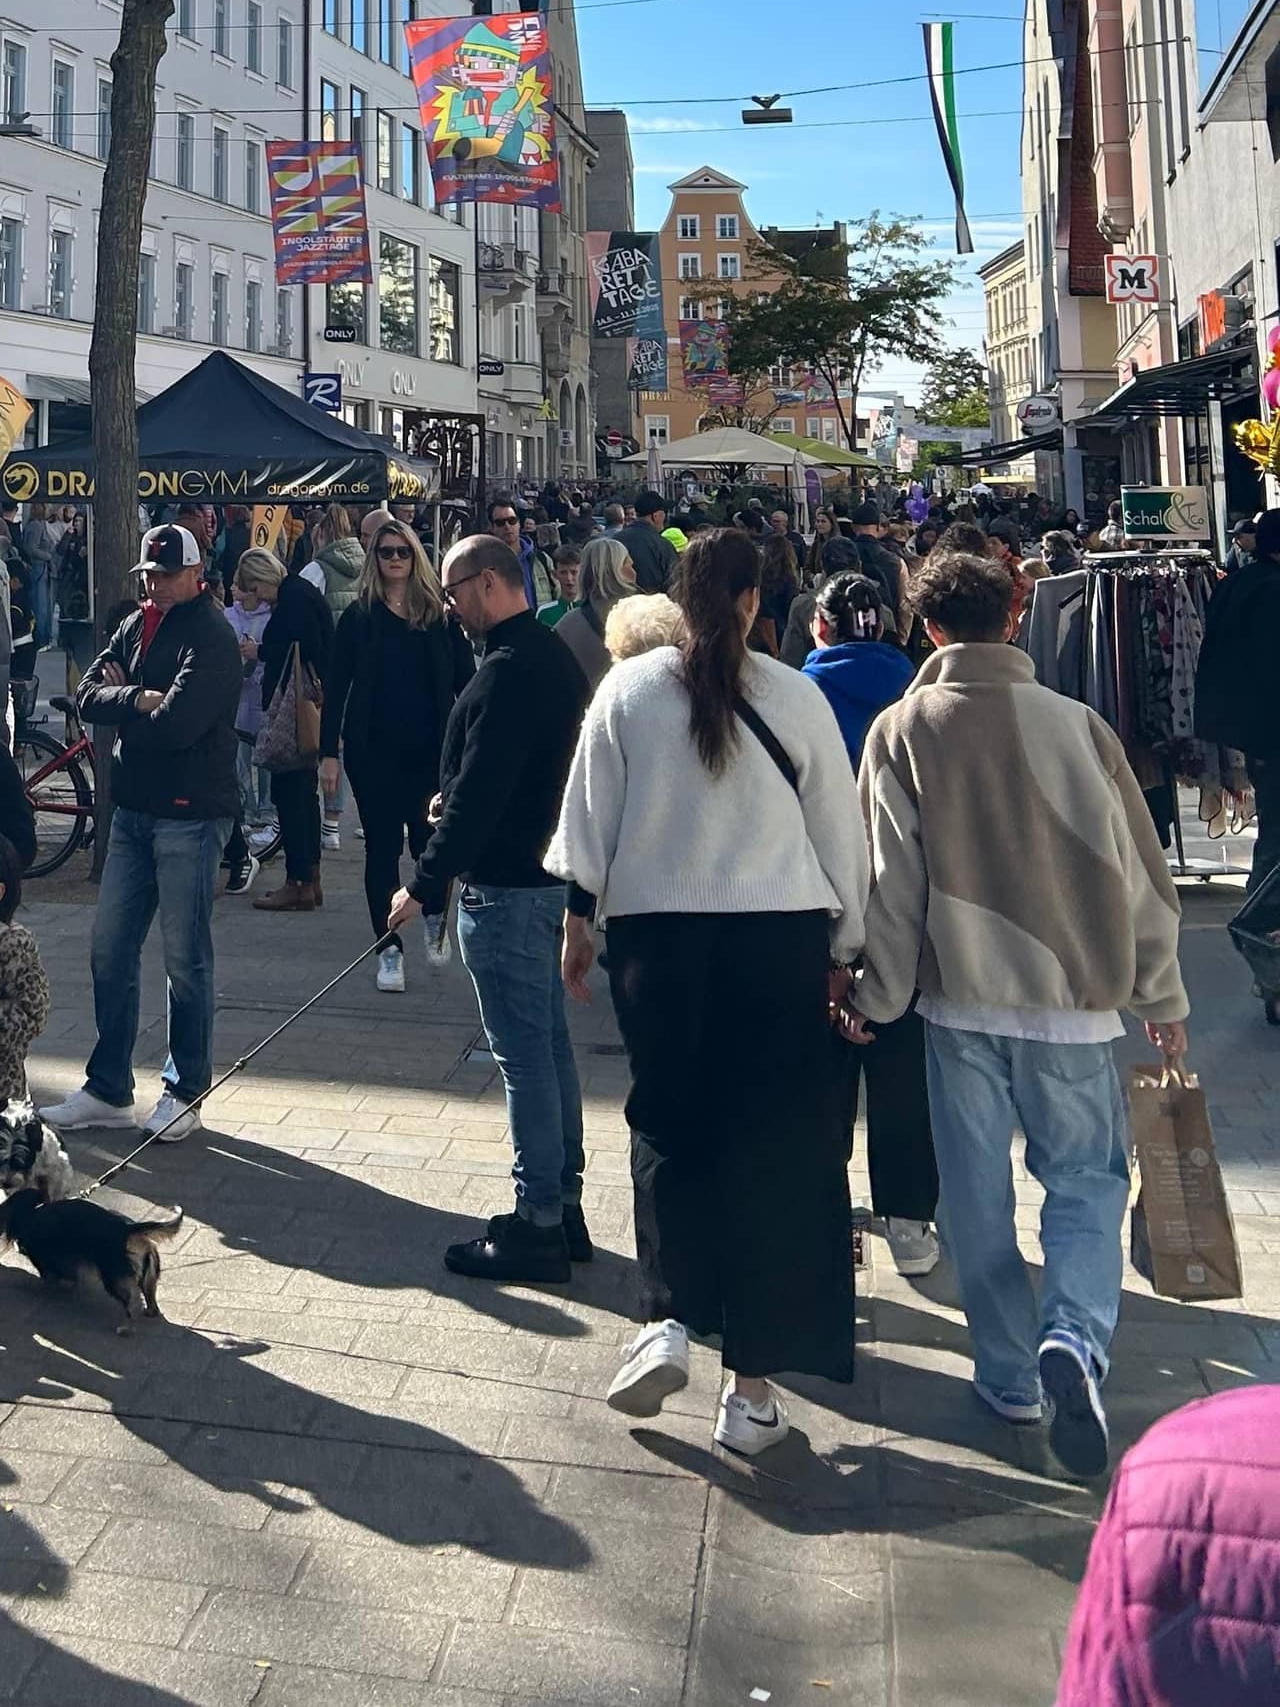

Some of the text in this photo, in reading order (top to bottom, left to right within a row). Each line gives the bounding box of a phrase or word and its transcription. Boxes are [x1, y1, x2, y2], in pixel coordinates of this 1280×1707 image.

[1118, 268, 1148, 290] M
[325, 329, 354, 339] ONLY
[337, 359, 364, 387] ONLY
[479, 365, 502, 373] ONLY
[392, 371, 418, 396] ONLY
[267, 481, 370, 497] dragongym.de
[1124, 509, 1163, 526] Schal
